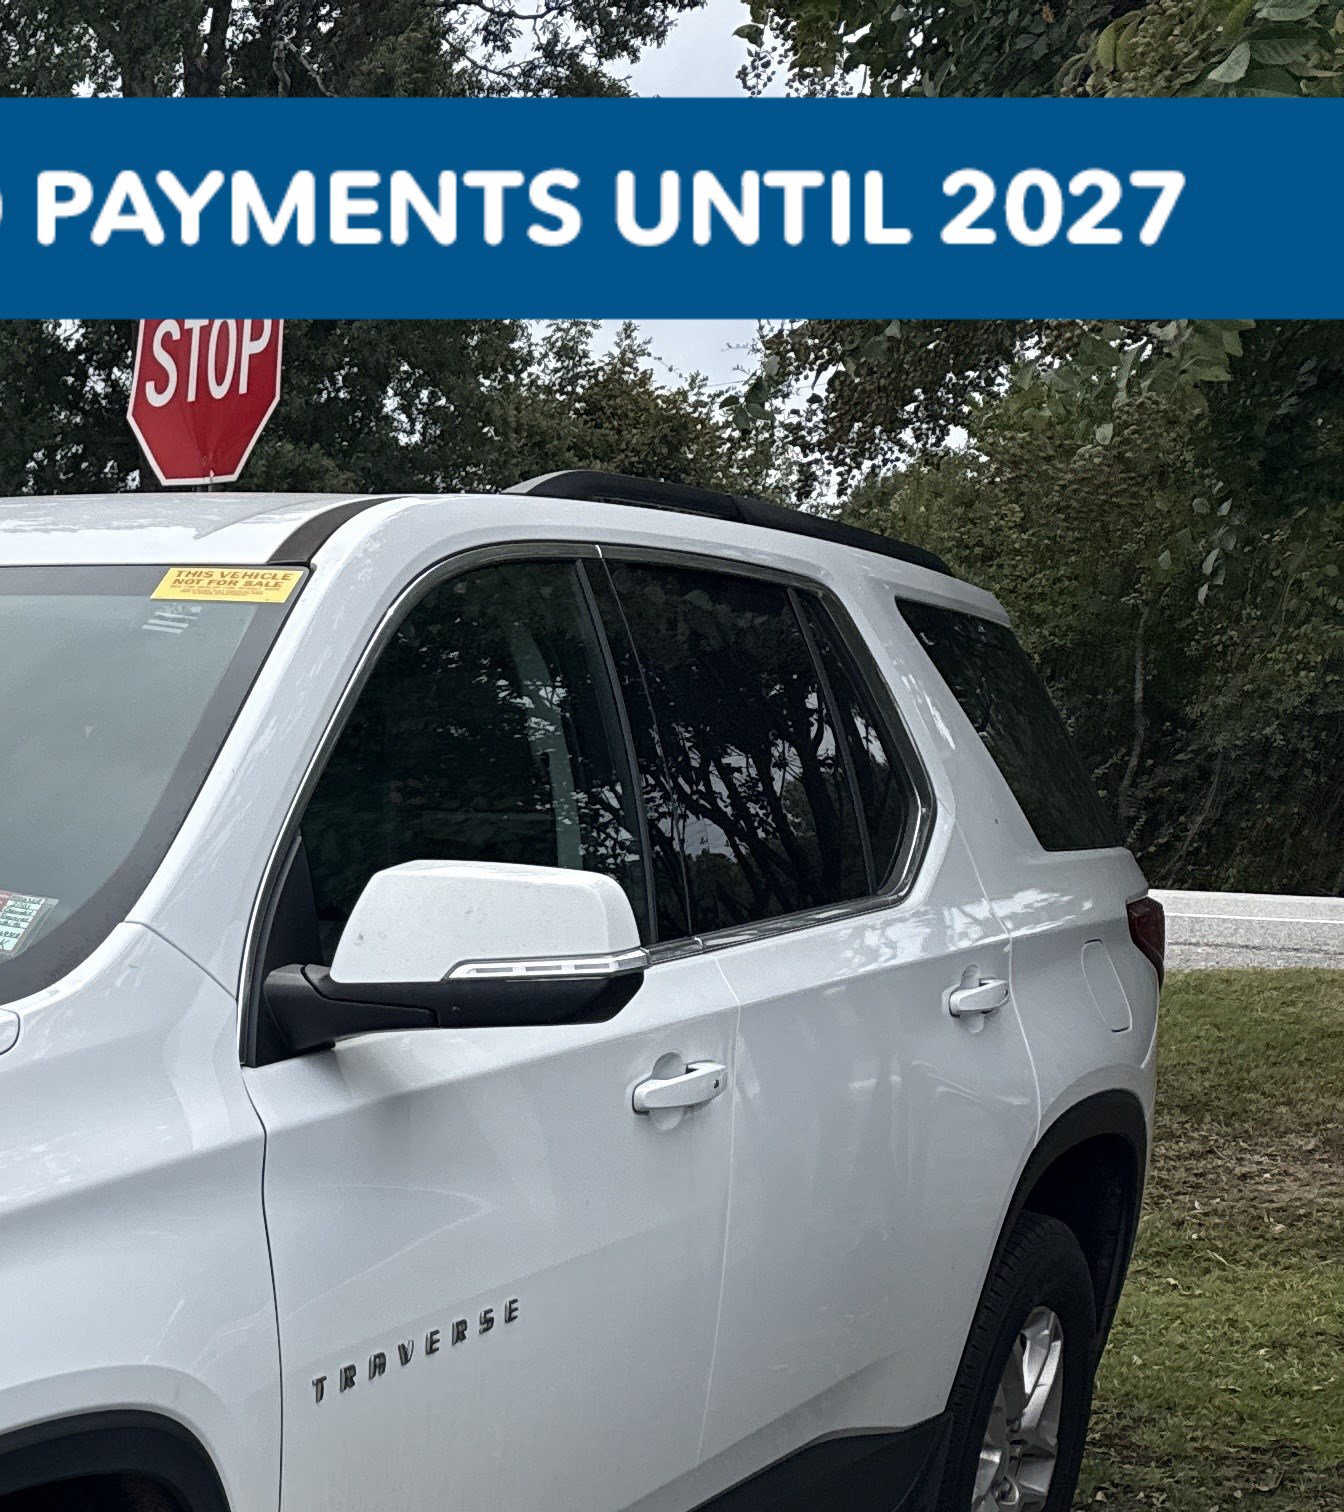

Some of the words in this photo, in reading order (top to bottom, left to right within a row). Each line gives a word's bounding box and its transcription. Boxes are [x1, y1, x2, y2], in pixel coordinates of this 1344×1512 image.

[145, 319, 271, 407] STOP
[175, 570, 215, 579] THIS
[220, 571, 296, 581] VEHICLE
[207, 579, 240, 587] FOR
[242, 580, 286, 588] SALE
[311, 1298, 520, 1403] TRAVERSE
